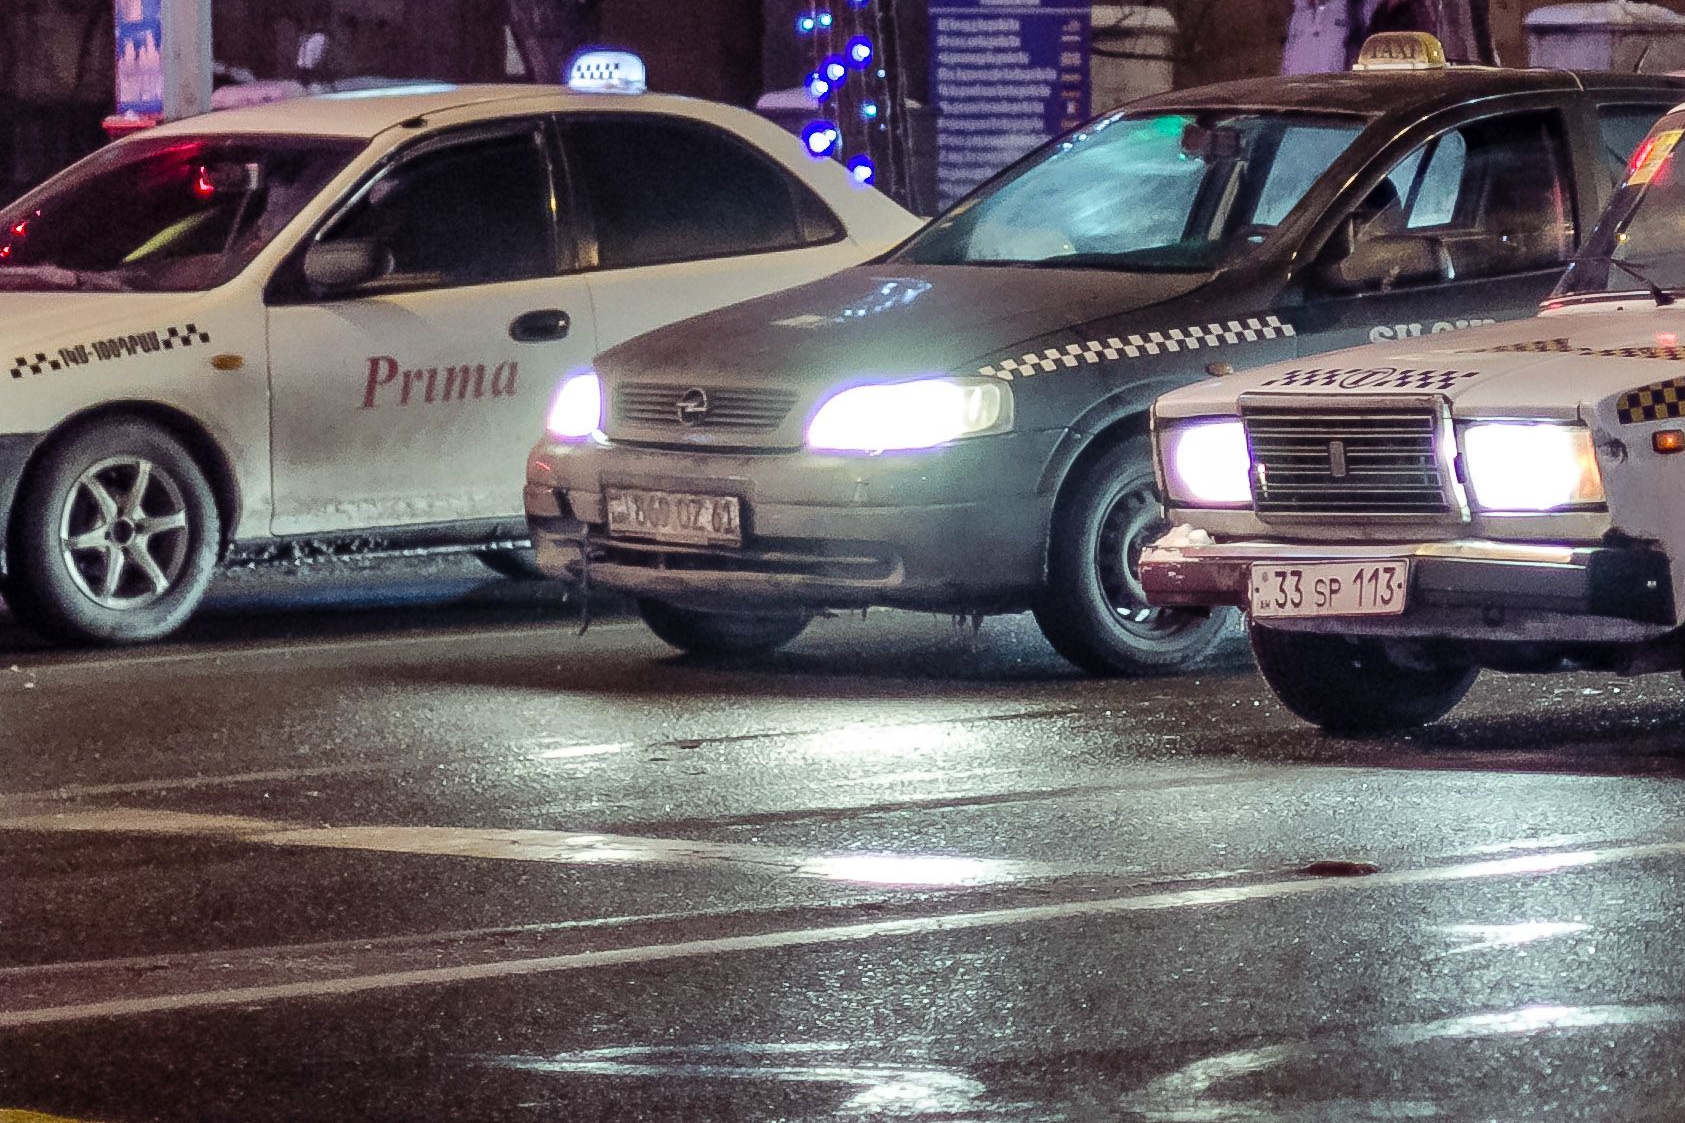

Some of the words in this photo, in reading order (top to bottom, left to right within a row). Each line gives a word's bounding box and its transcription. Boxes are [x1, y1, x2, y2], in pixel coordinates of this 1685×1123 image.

[360, 355, 519, 409] Prima
[1275, 570, 1304, 609] 33
[1314, 577, 1342, 608] SP
[1353, 567, 1396, 606] 113
